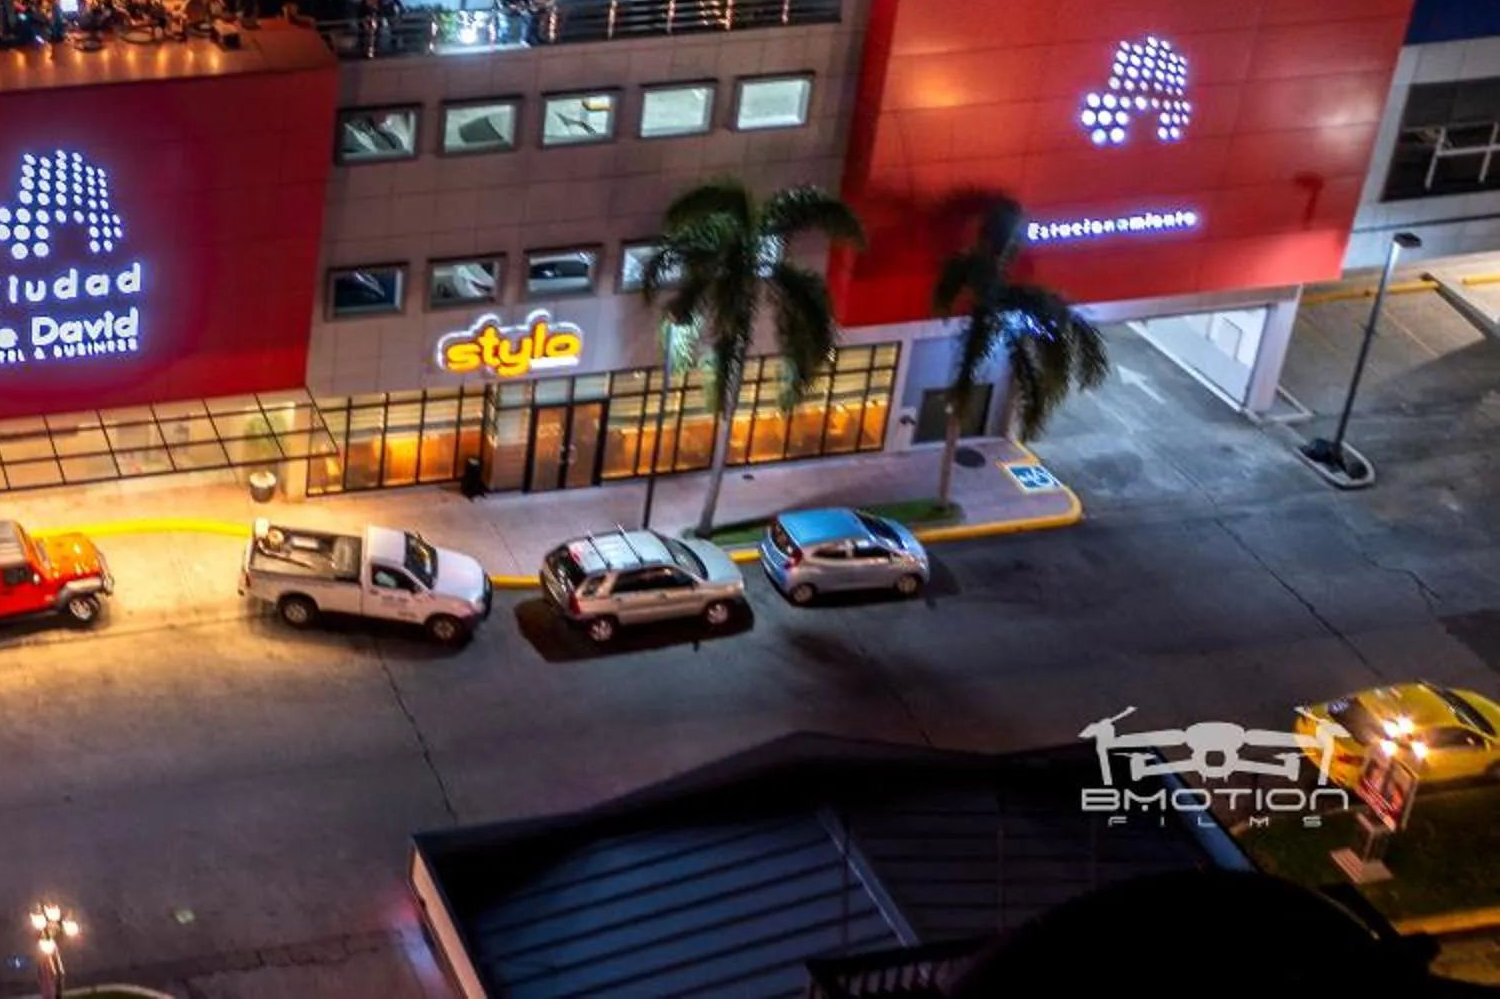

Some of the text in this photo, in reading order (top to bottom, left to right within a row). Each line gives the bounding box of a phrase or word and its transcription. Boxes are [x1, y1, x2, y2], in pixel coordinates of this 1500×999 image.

[1027, 210, 1197, 240] Estacionamiento
[31, 307, 139, 345] David
[34, 346, 45, 360] &
[53, 338, 138, 358] BUSINESS
[445, 321, 581, 376] stylo
